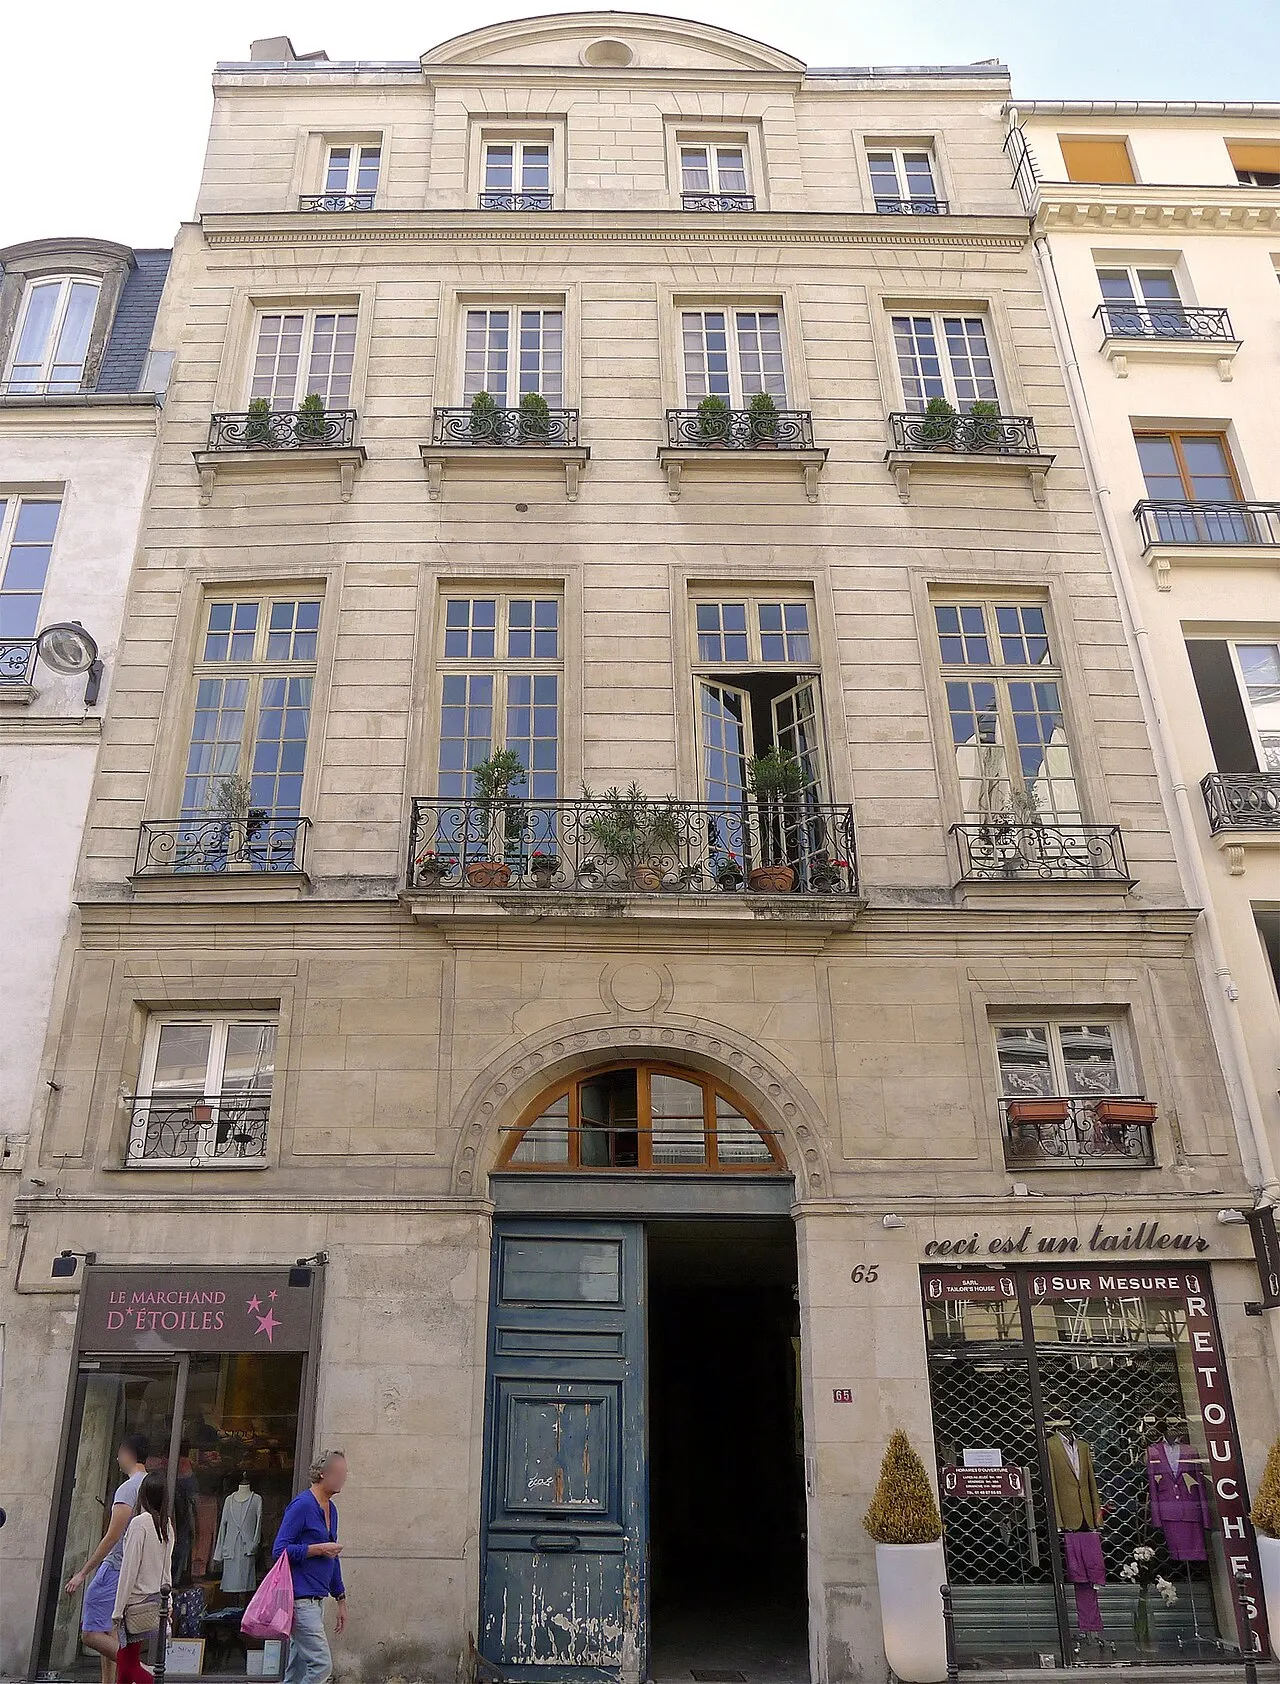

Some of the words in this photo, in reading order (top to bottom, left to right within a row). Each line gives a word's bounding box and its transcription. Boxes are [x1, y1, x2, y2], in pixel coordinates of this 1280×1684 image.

[925, 1232, 979, 1256] ceci
[988, 1225, 1033, 1254] est
[1037, 1234, 1081, 1254] un
[1089, 1221, 1210, 1253] tailleur
[850, 1264, 879, 1284] 65
[1052, 1276, 1092, 1290] SUR
[1099, 1275, 1180, 1290] MESURE
[109, 1291, 126, 1304] LE
[131, 1291, 226, 1304] MARCHAND
[835, 1390, 850, 1401] 65
